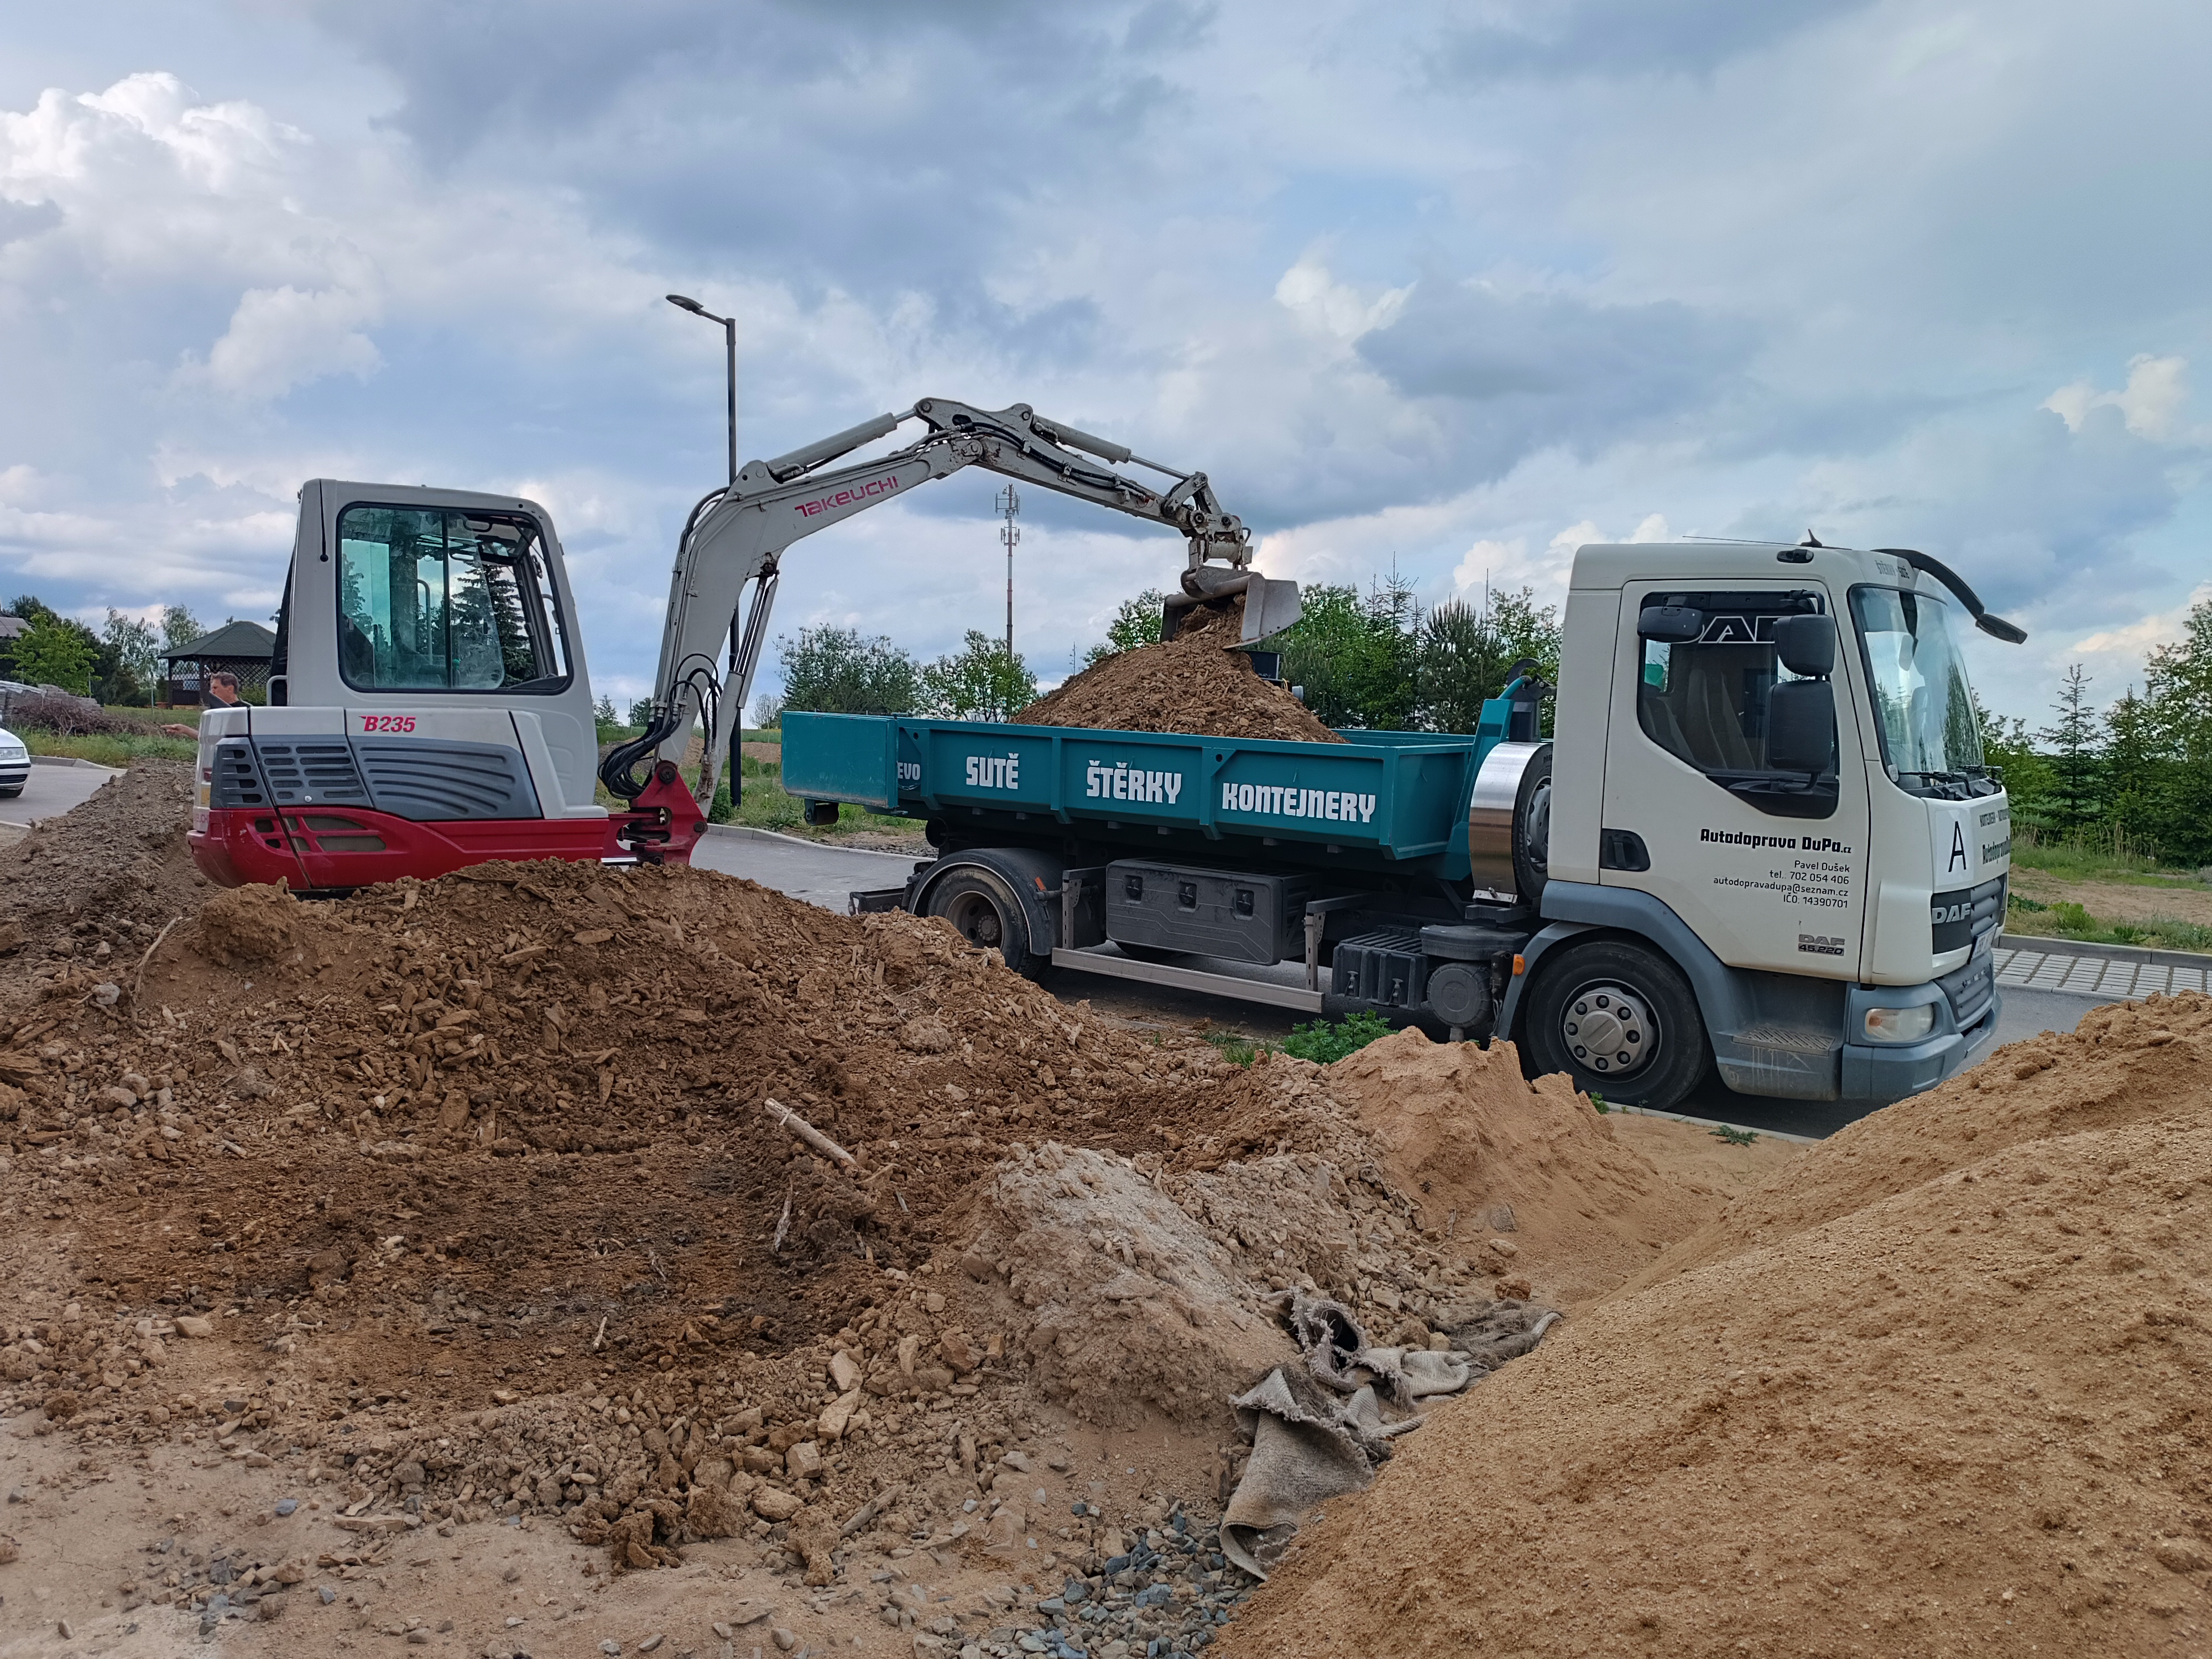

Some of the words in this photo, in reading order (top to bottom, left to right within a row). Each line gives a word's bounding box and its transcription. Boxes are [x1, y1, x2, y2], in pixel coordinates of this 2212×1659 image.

[966, 753, 1019, 790] SUTĚ
[1087, 760, 1181, 804] ŠTĚRKY
[1222, 782, 1376, 823] KONTEJNERY
[1700, 829, 1796, 849] Autodoprava
[1948, 821, 1966, 872] A
[1794, 860, 1819, 870] Pavel
[1822, 863, 1850, 872] Dušek
[1713, 877, 1848, 896] autodopravadupa@seznam.cz
[1790, 872, 1807, 880] 702
[1810, 873, 1828, 883] 054
[1831, 875, 1849, 884] 406
[1803, 896, 1848, 908] 14390701
[1932, 902, 1971, 924] DAF
[1799, 934, 1845, 946] DAF
[1799, 945, 1843, 954] 45.220
